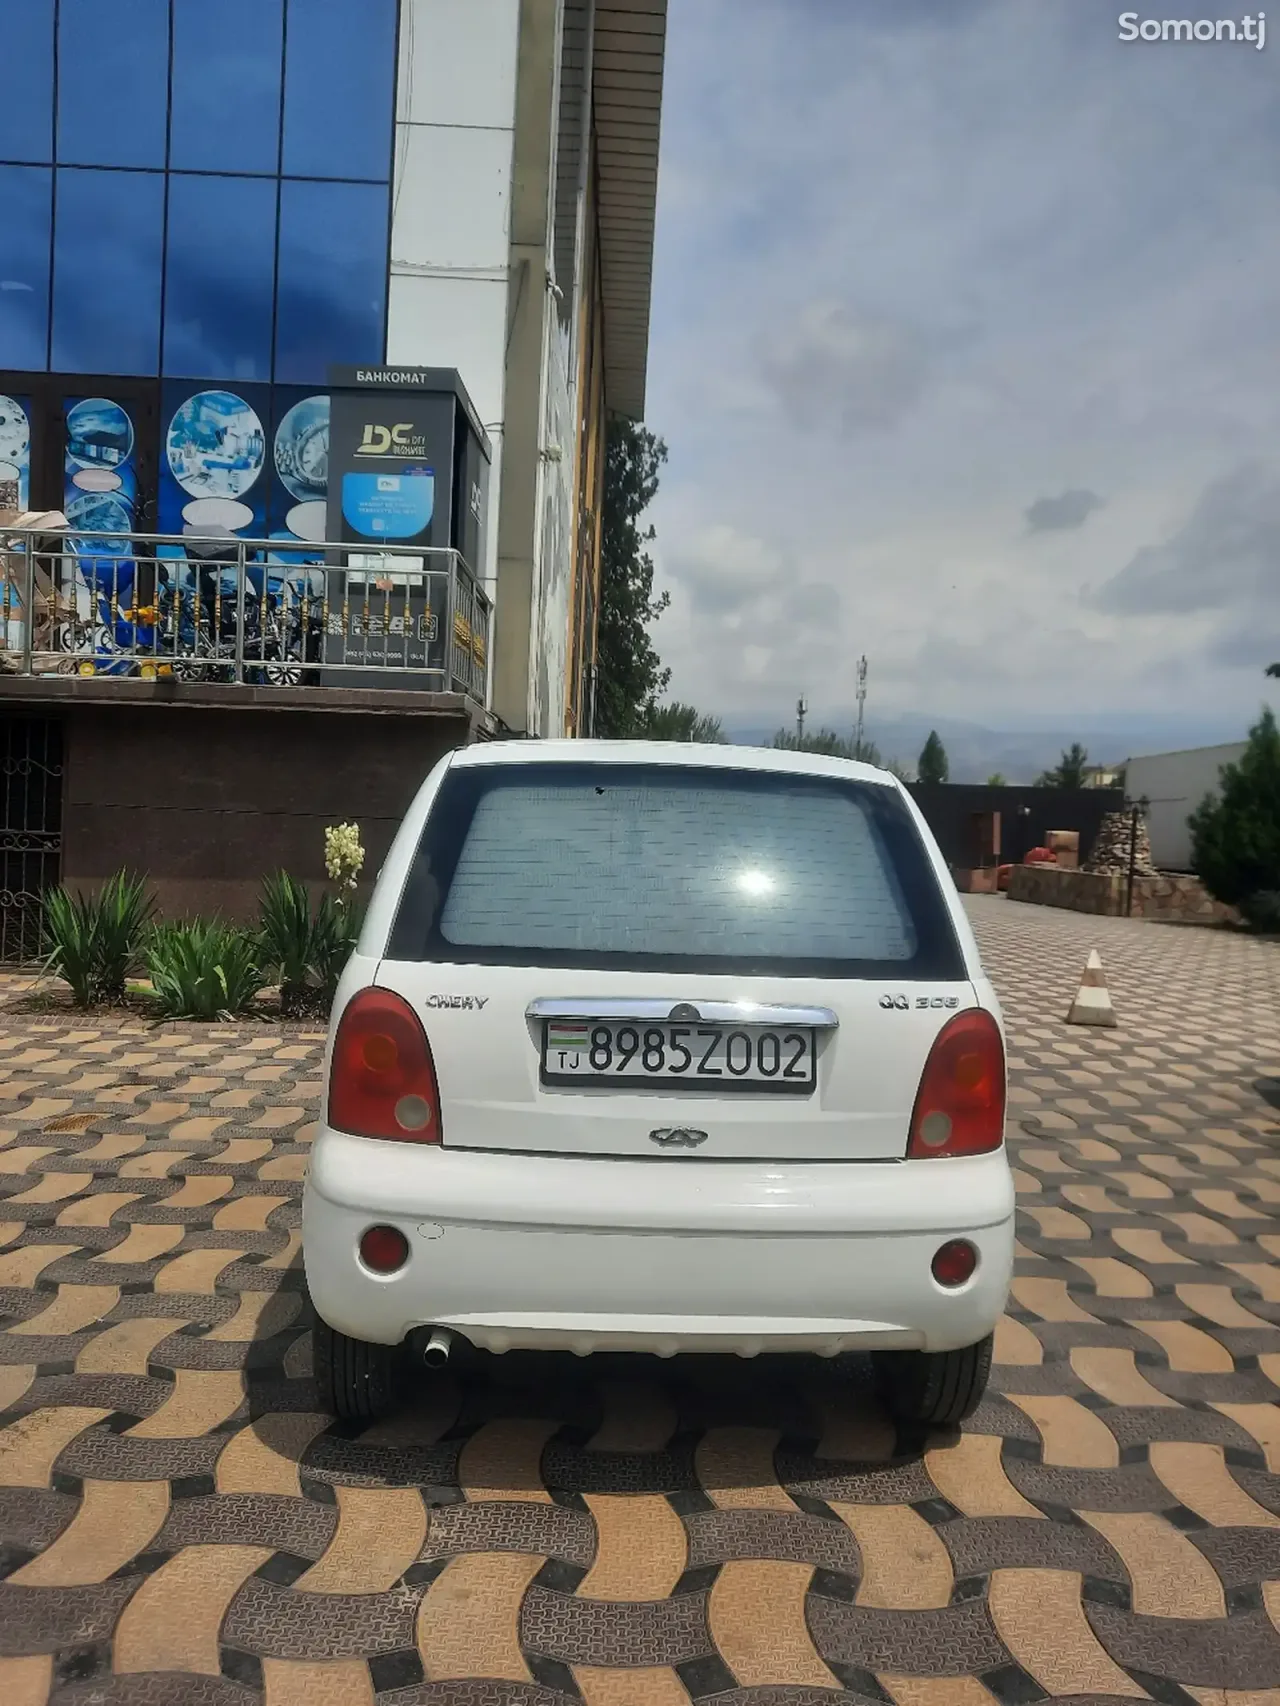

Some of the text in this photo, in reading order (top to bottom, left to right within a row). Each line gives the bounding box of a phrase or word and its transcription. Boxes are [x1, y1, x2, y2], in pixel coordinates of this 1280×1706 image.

[356, 370, 427, 384] БАНКОМАТ
[356, 423, 414, 454] DC
[425, 994, 489, 1010] CHERY
[879, 994, 910, 1010] QQ
[557, 1051, 580, 1070] TJ
